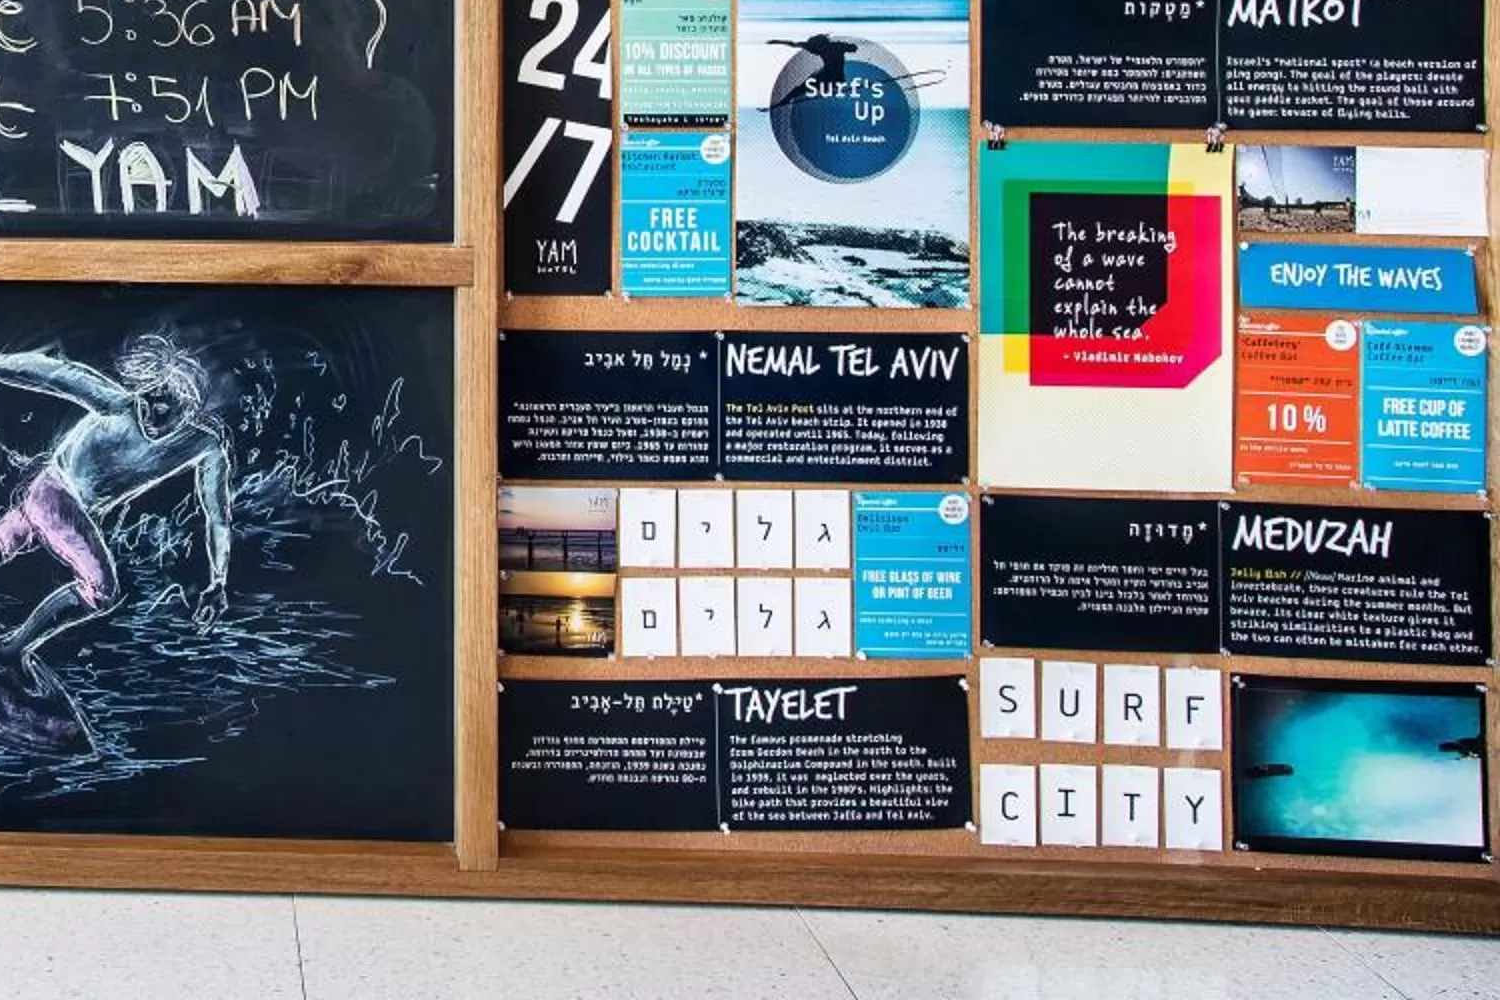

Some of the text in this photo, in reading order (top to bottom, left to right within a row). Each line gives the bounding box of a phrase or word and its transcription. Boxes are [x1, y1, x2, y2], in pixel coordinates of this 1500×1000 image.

[659, 42, 726, 61] DISCOUNT
[84, 71, 216, 128] 7:51
[240, 68, 318, 121] PM
[804, 77, 885, 100] Surf's
[855, 102, 885, 126] Up
[60, 139, 261, 220] YAM
[651, 208, 697, 228] FREE
[627, 231, 721, 252] COCKTAIL
[1052, 222, 1177, 254] The breaking
[536, 239, 577, 264] YAM
[1054, 246, 1146, 273] of a wave
[1054, 275, 1115, 292] cannot
[1270, 261, 1443, 292] ENJOY THE WAVES
[1053, 297, 1158, 322] explain the
[1053, 321, 1150, 341] whole sea.
[726, 343, 959, 381] NEMAL TEL AVIV
[1382, 397, 1467, 417] FREE CUP OF
[1377, 419, 1472, 440] LATTE COFFEE
[1232, 514, 1393, 559] MEDUZAH
[723, 685, 857, 723] TAYELET
